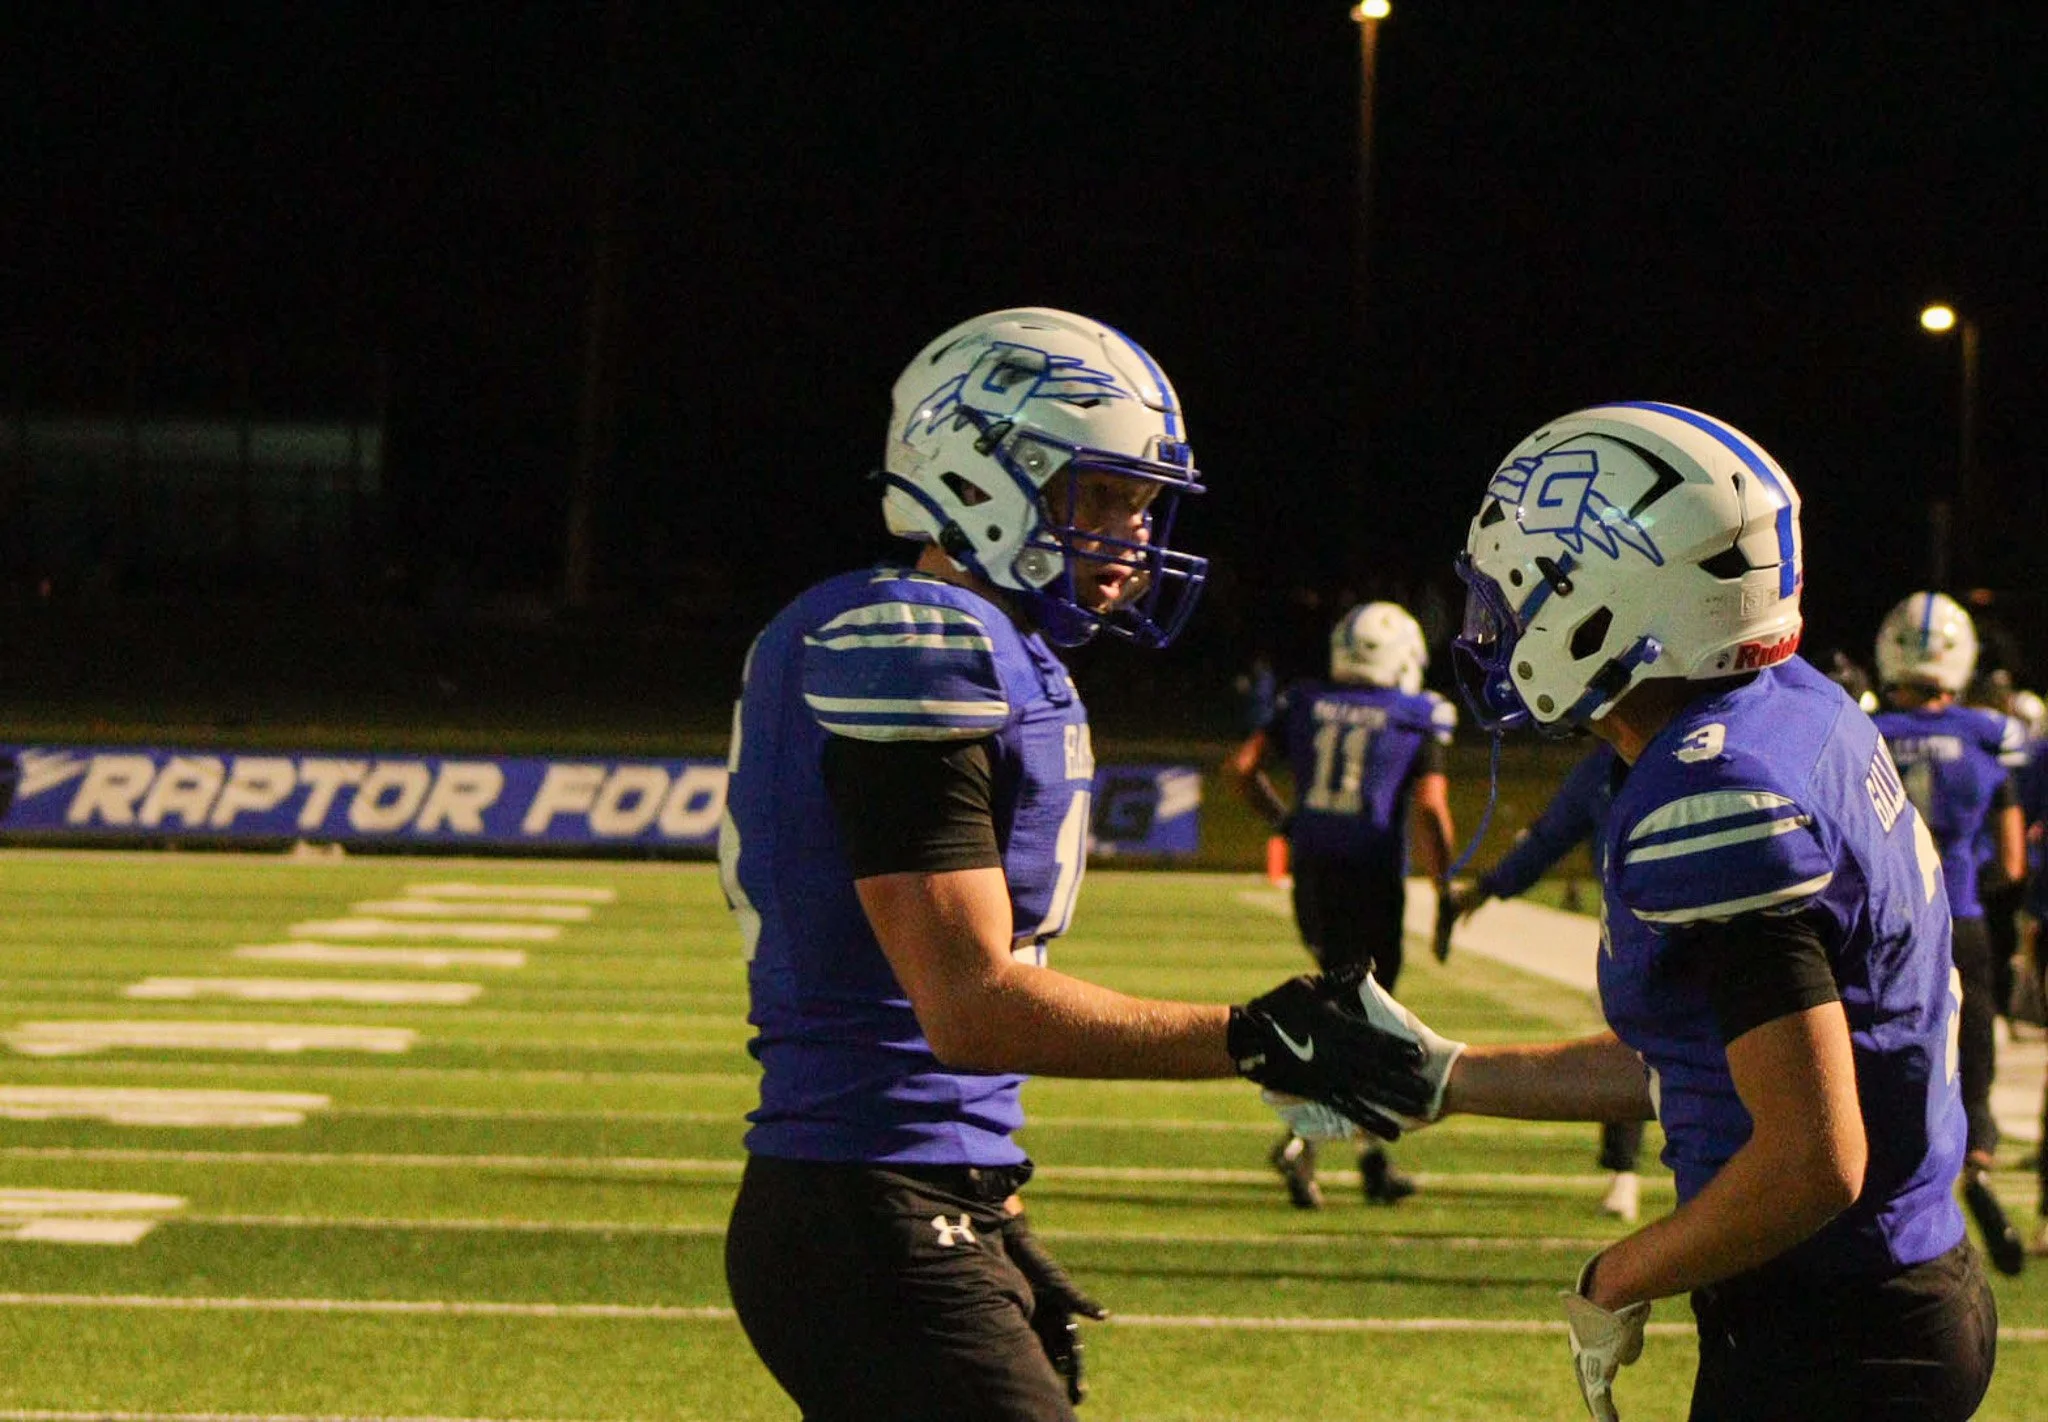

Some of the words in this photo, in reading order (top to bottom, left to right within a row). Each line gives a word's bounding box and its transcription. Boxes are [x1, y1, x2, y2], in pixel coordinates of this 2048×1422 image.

[1303, 723, 1370, 814] 11
[1673, 722, 1726, 763] 3
[66, 754, 504, 834] RAPTOR
